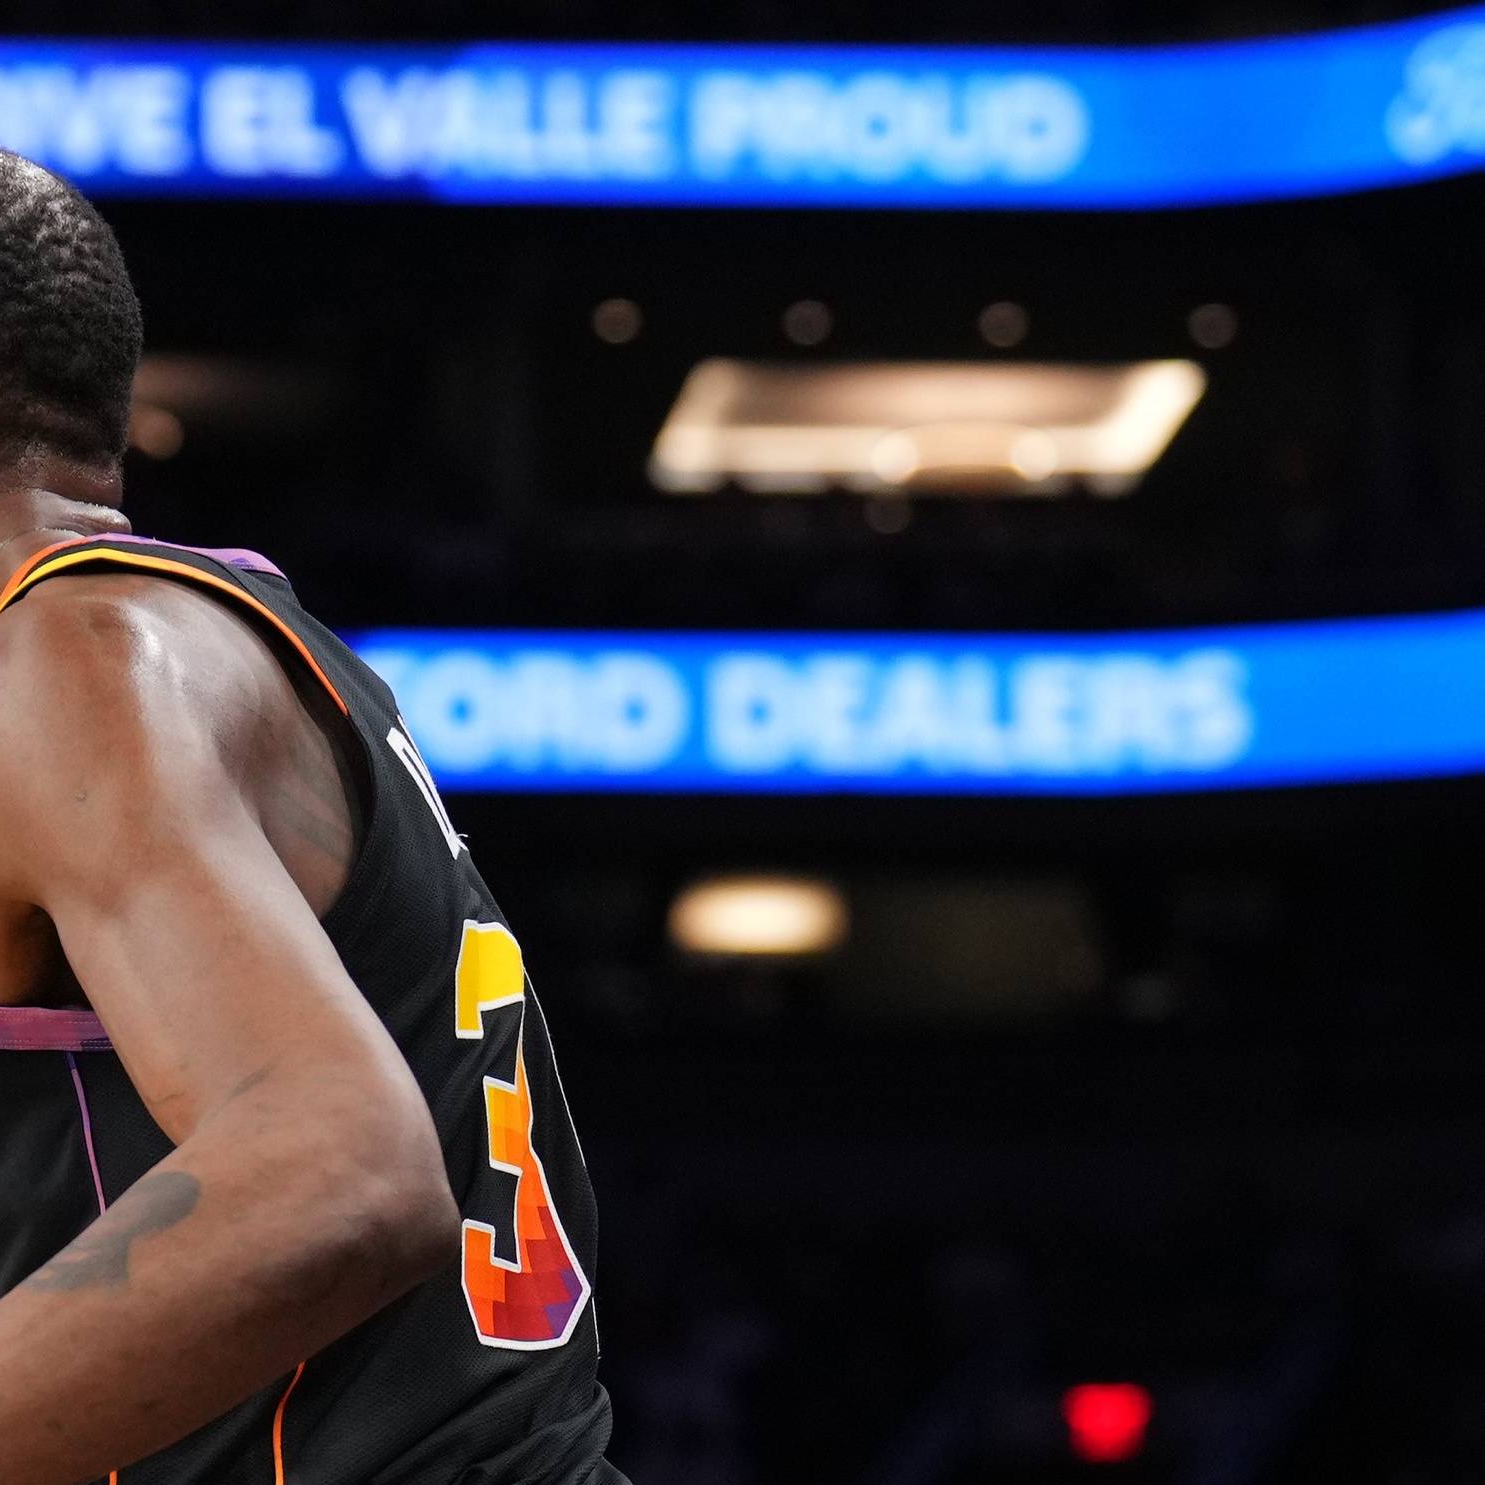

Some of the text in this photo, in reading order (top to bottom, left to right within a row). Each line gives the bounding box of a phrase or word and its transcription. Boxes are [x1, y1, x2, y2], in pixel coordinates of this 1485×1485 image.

[203, 68, 339, 177] EL
[341, 70, 675, 180] VALLE
[688, 74, 1089, 184] PROUD
[706, 652, 1252, 774] DEALERS
[453, 918, 595, 1354] 3
